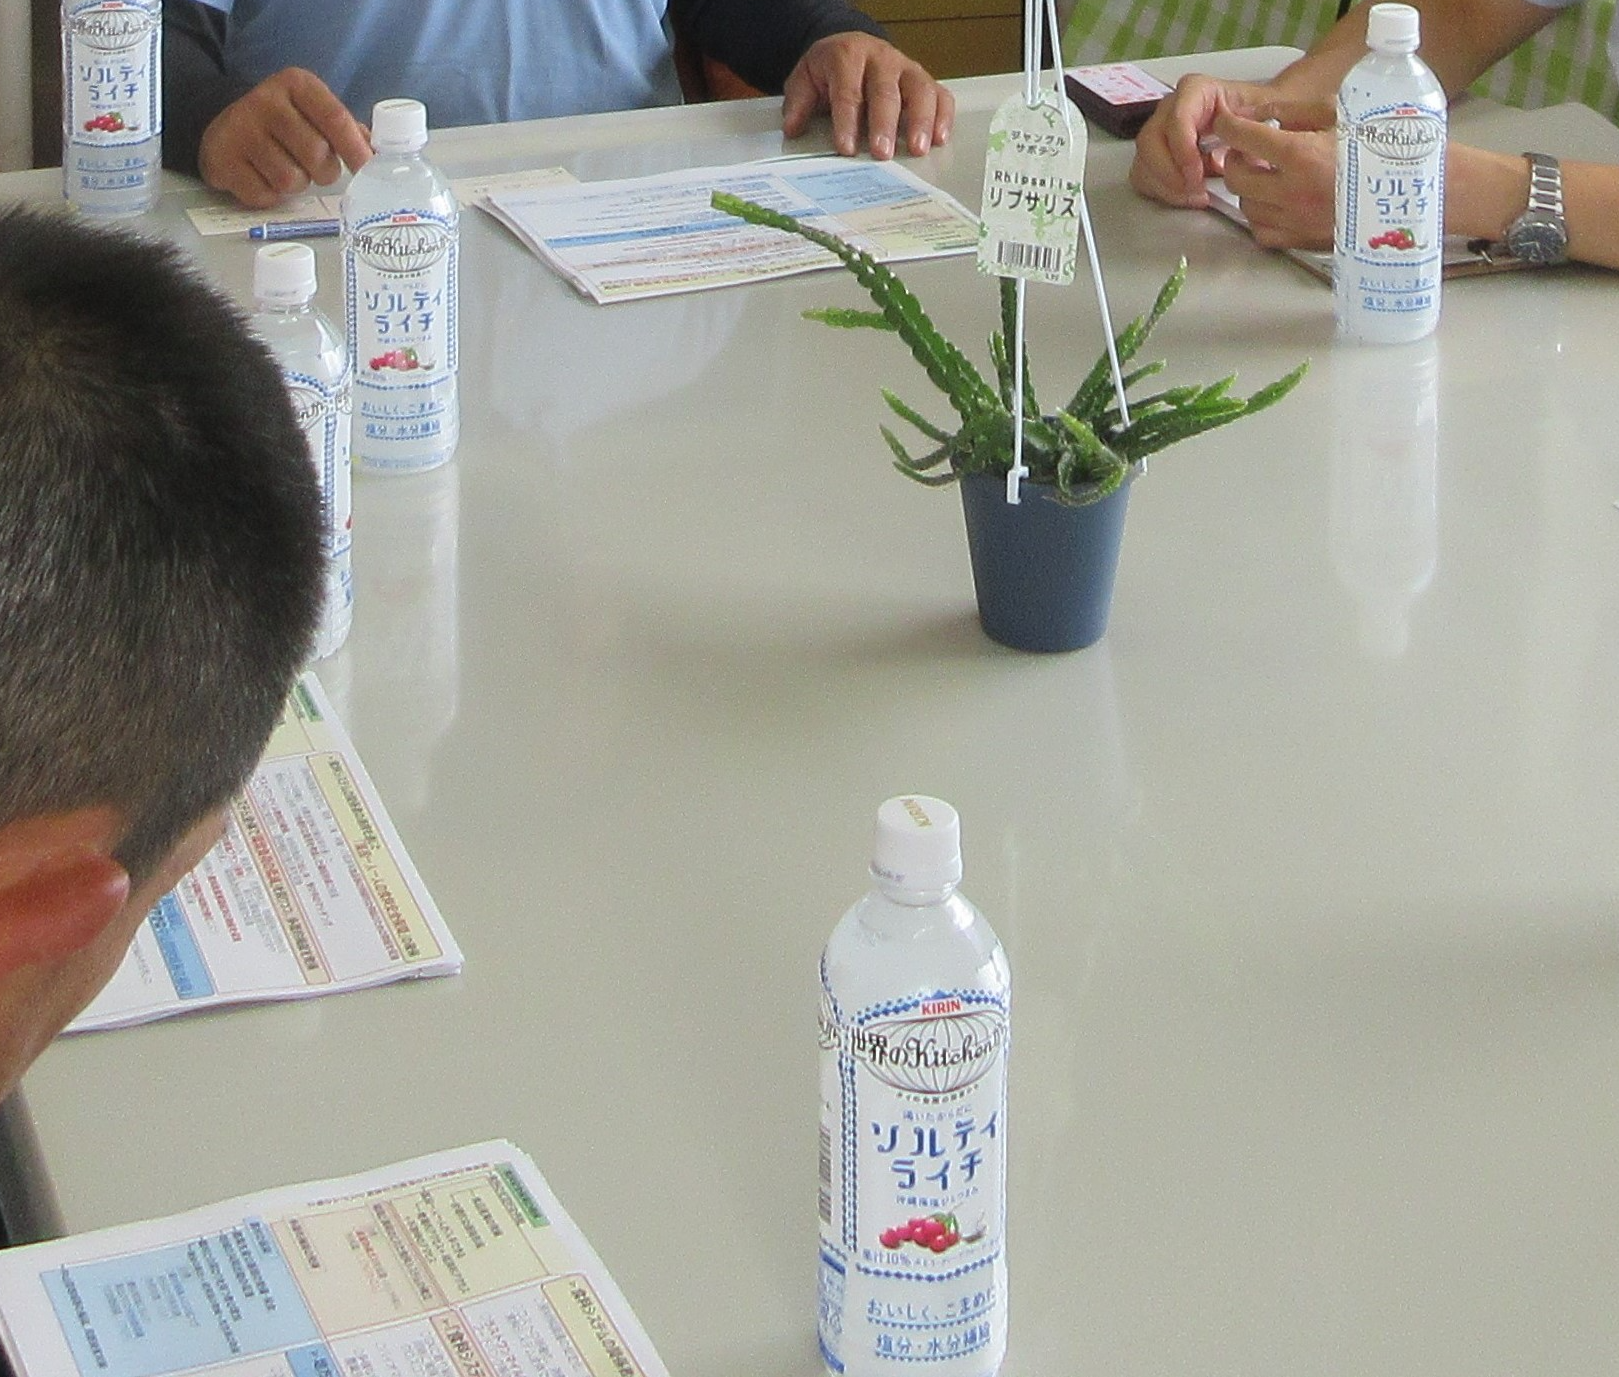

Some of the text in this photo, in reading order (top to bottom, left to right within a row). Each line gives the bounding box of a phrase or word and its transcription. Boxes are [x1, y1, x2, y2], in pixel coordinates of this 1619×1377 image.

[80, 64, 147, 84] ソルティ
[88, 84, 139, 101] ライチ
[1010, 129, 1066, 147] ジャングル
[1015, 142, 1061, 157] サボテン
[994, 170, 1074, 191] Rhipsalis
[1367, 175, 1435, 197] ソルティ
[1376, 197, 1428, 216] ライチ
[365, 289, 441, 311] ソルティ
[375, 312, 434, 334] ライチ
[921, 998, 962, 1016] KIRIN
[871, 1109, 998, 1158] ソルティ
[891, 1147, 983, 1191] ライチ
